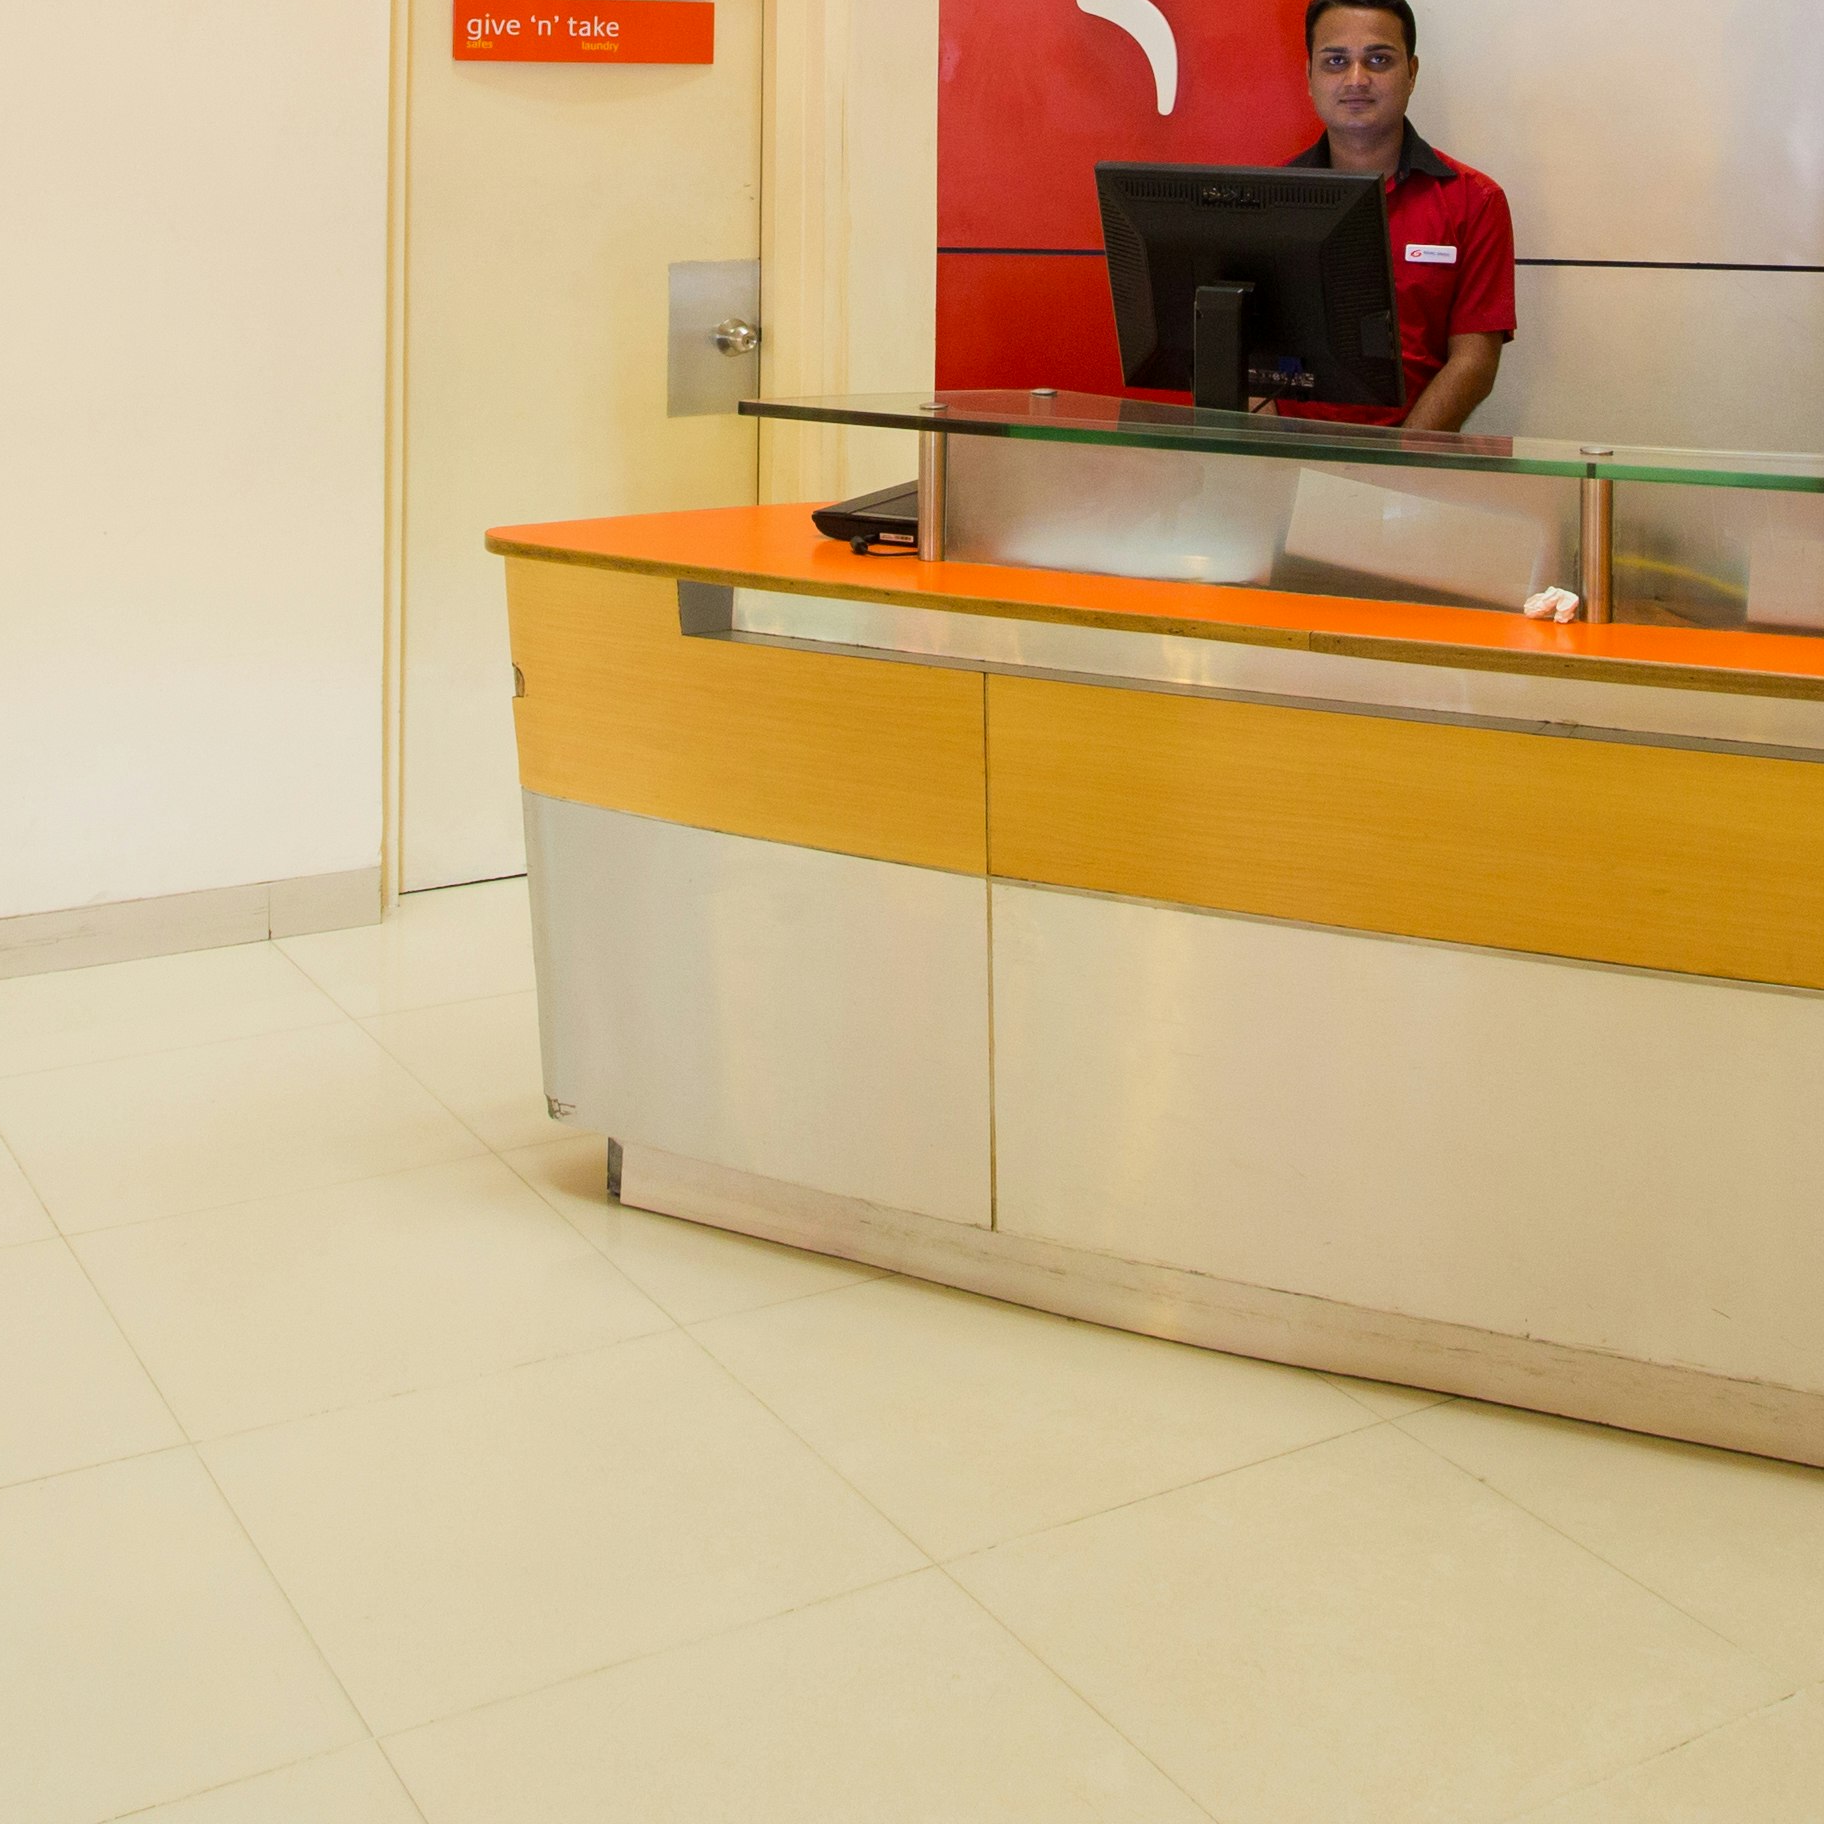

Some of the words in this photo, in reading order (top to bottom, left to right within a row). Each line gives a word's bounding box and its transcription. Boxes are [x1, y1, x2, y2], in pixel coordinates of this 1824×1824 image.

[467, 13, 521, 40] give
[567, 16, 619, 37] take
[466, 38, 493, 49] safes
[581, 41, 619, 52] laundry
